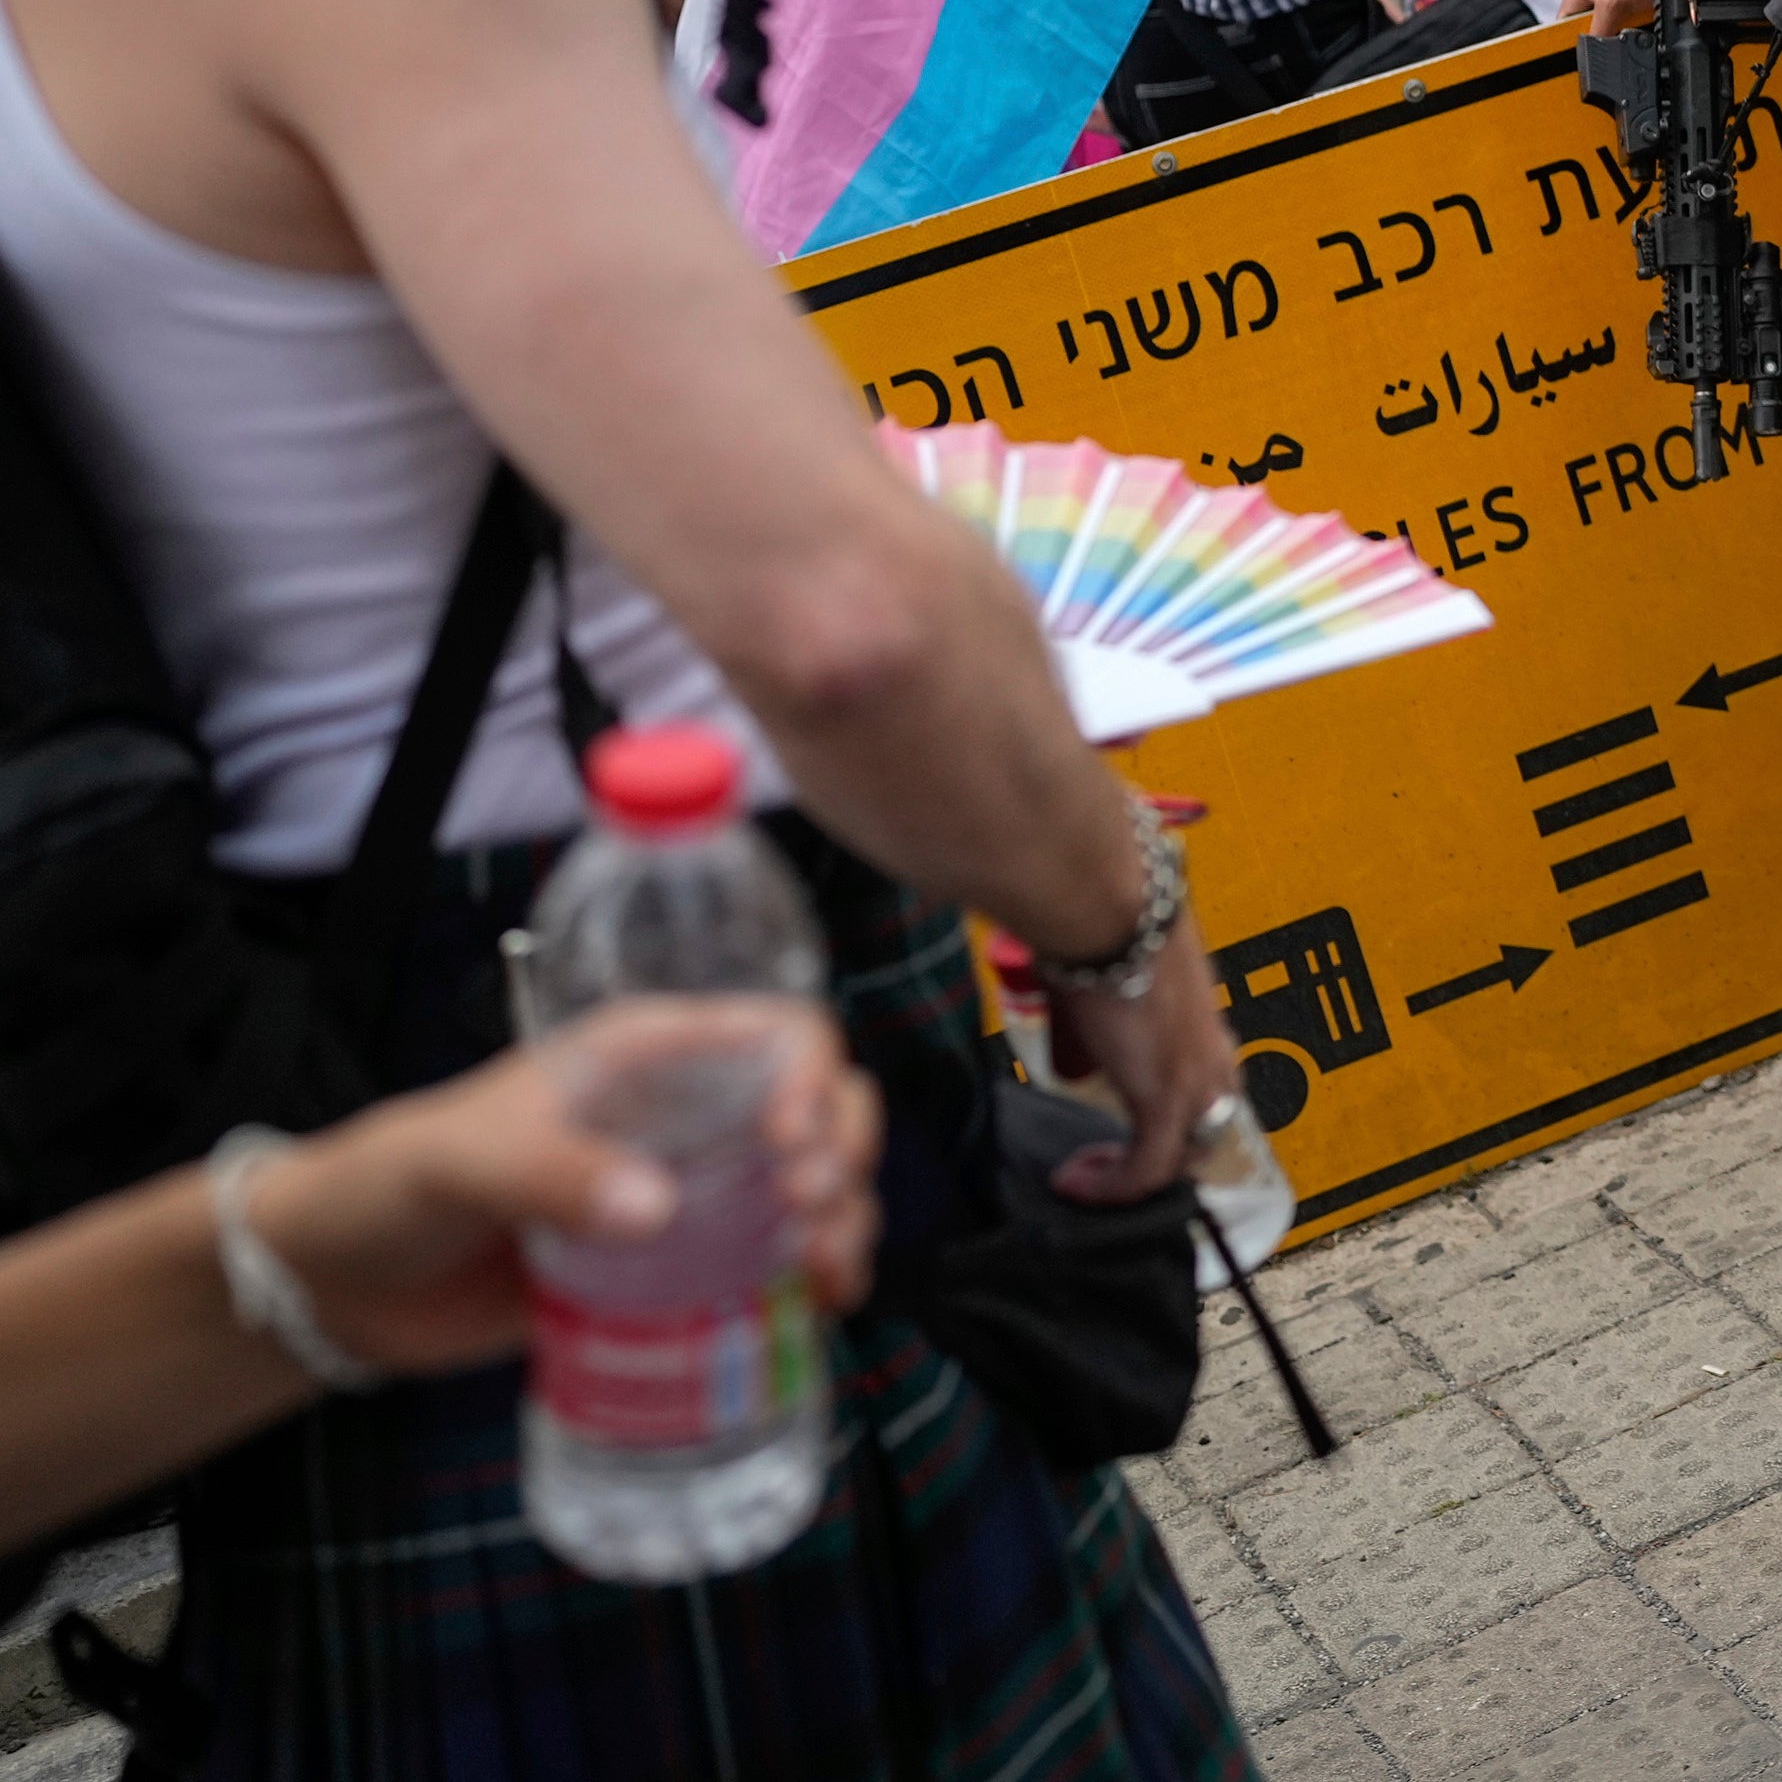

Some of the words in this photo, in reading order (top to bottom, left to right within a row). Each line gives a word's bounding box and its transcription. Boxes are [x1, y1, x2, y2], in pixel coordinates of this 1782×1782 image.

[1316, 192, 1494, 303] רכב
[1056, 259, 1279, 380] משני
[1375, 326, 1617, 437] سيارات
[1564, 402, 1765, 526] FROM
